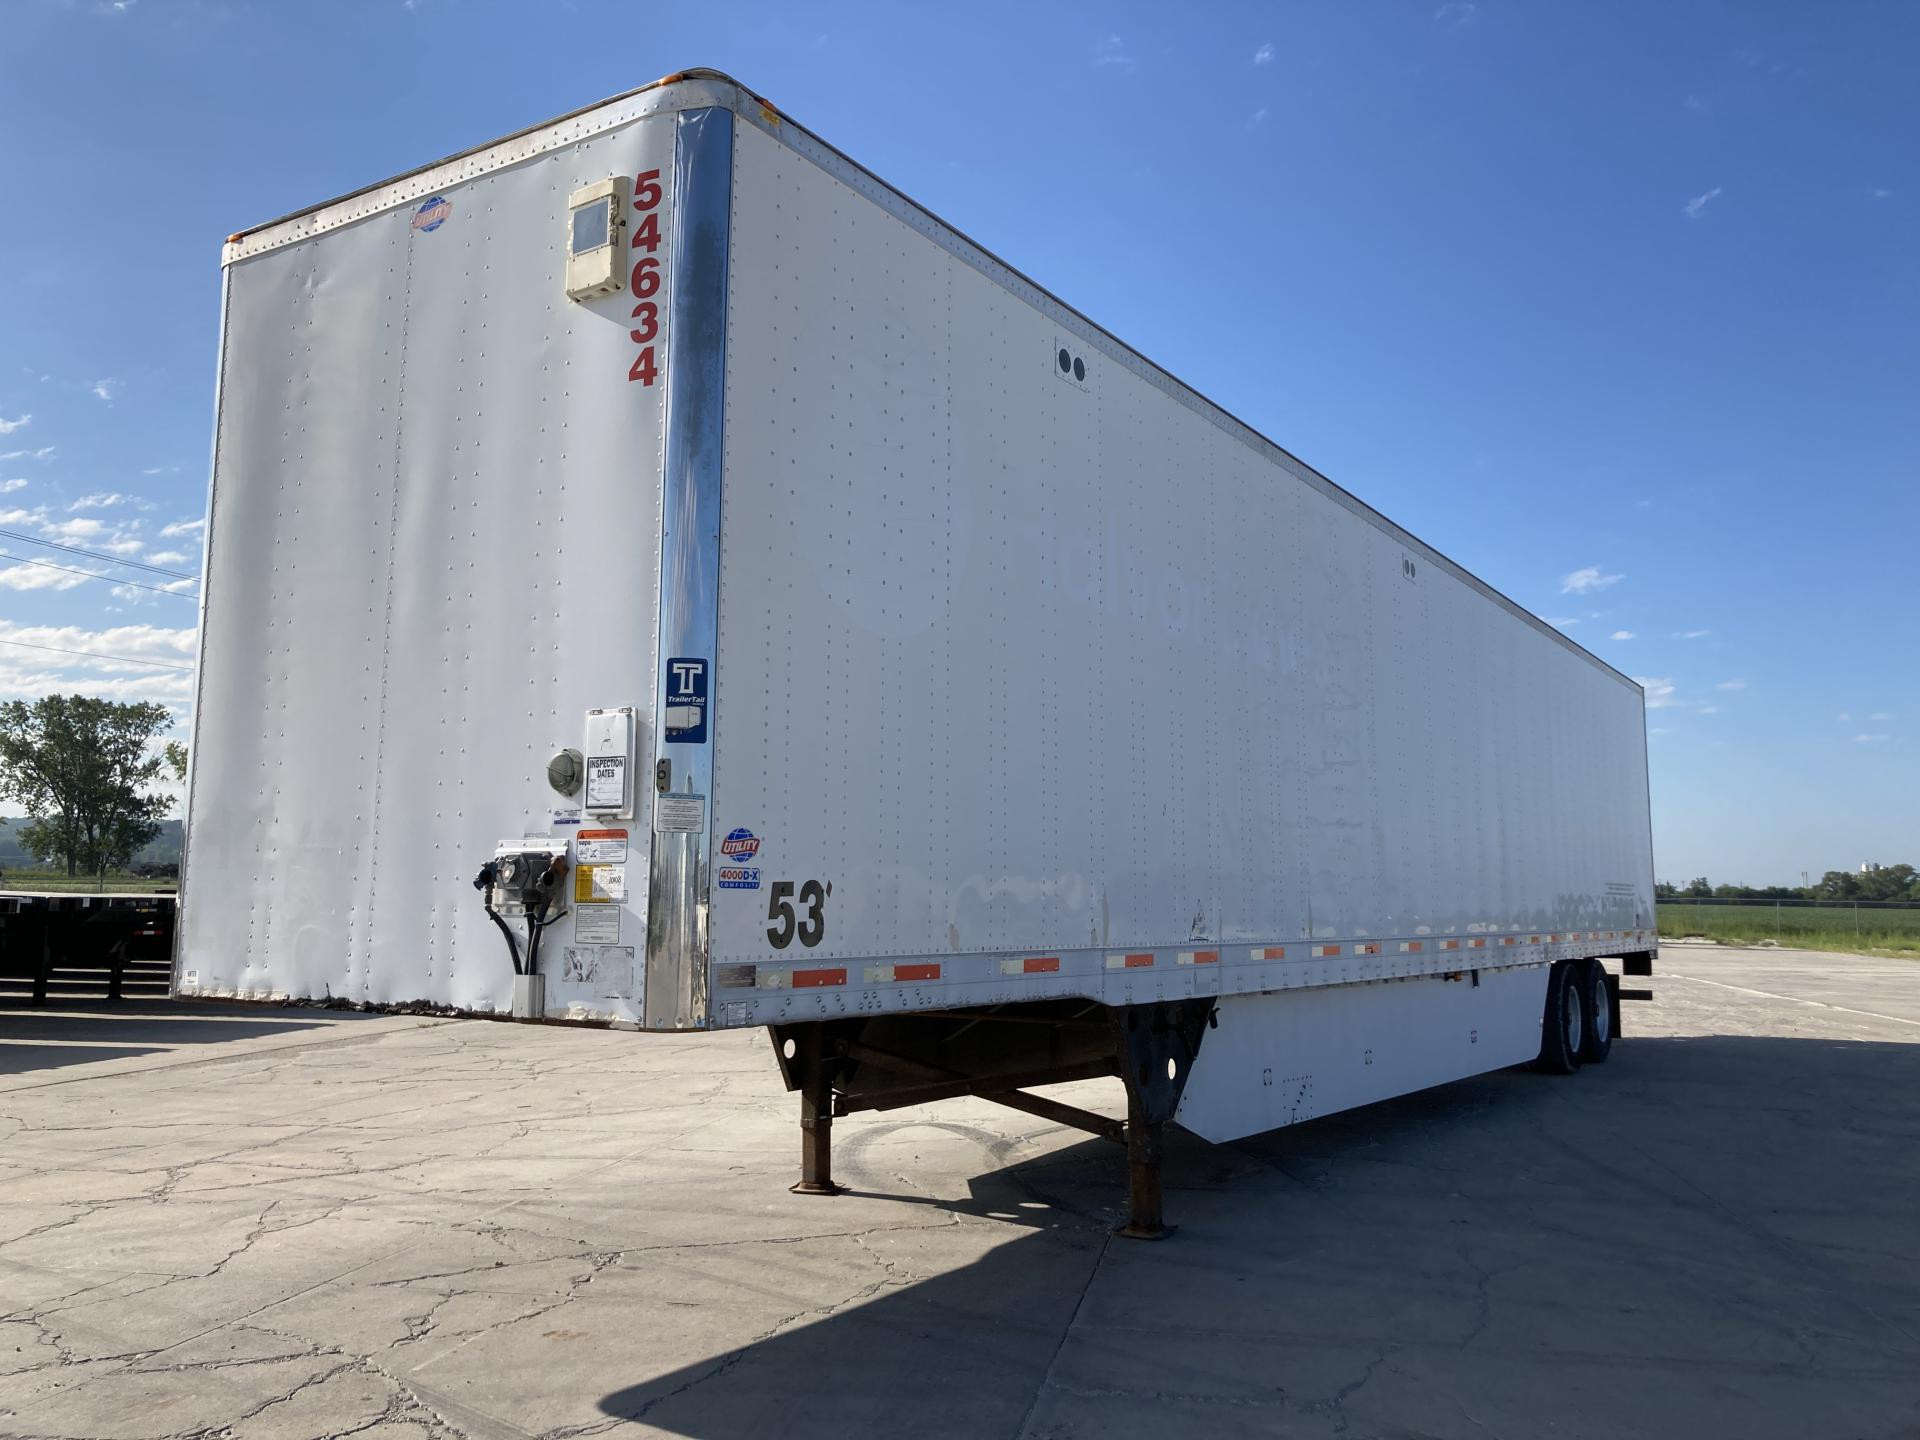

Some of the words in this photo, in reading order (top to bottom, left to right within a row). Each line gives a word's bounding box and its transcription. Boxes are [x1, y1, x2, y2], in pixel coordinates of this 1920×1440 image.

[629, 168, 662, 387] 54634
[590, 759, 624, 768] INSPECTION
[597, 769, 615, 778] DATES
[724, 840, 758, 853] UTILITY
[721, 870, 758, 880] 4000D-X
